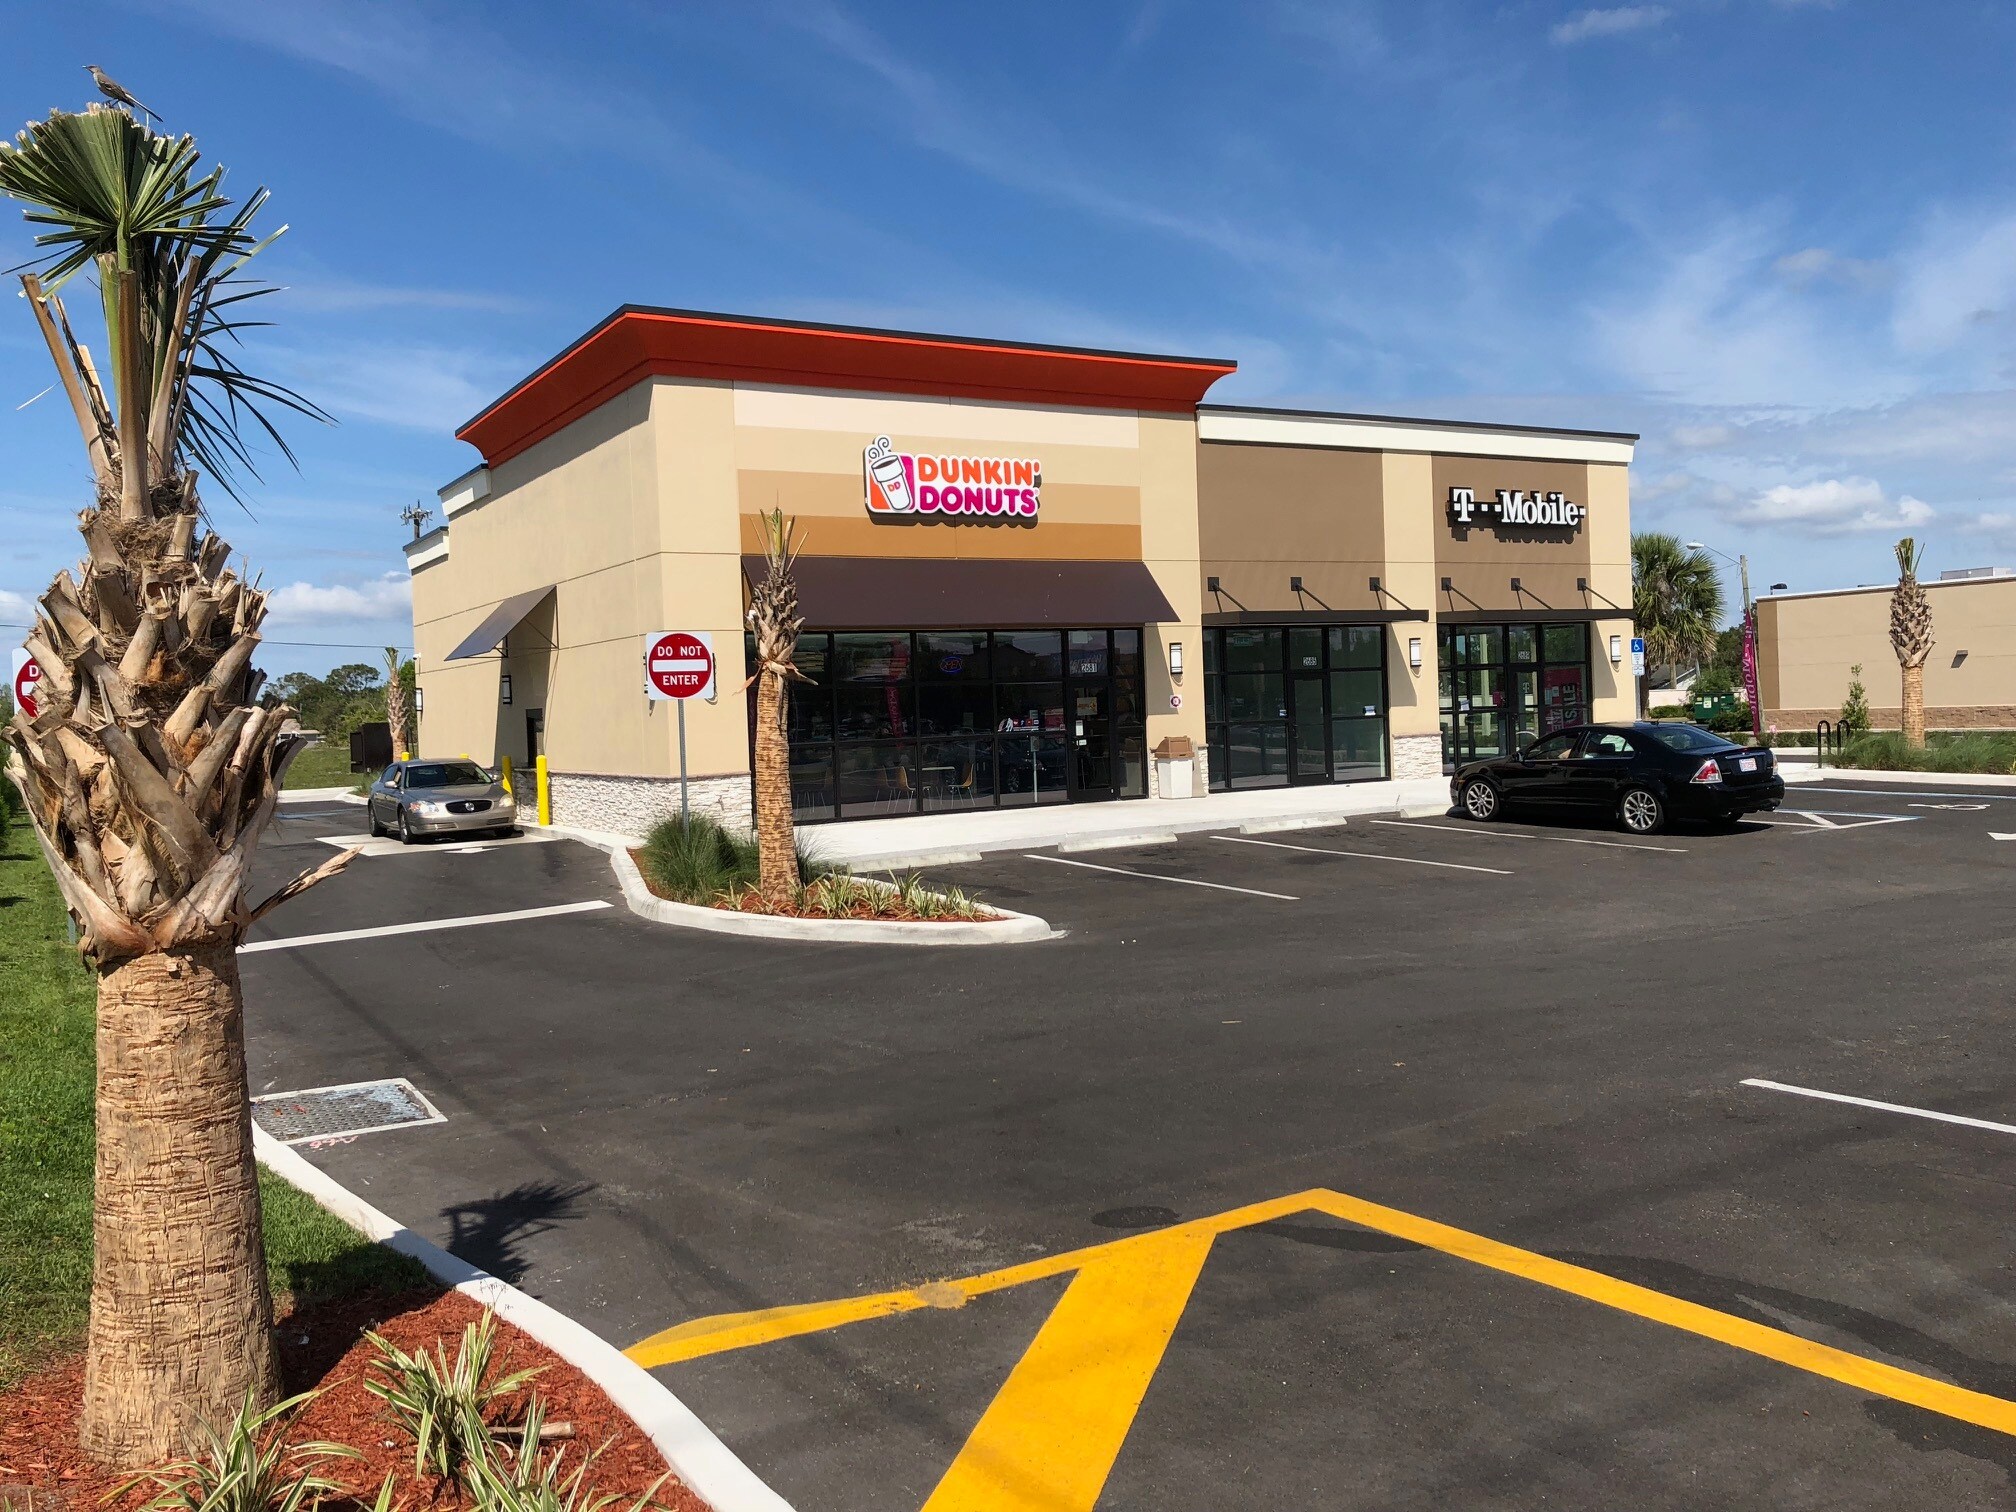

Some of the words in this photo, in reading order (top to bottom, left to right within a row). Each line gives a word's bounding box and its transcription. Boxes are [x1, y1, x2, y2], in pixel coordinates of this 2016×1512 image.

[918, 457, 1039, 486] DUNKIN'
[887, 481, 901, 492] DD
[919, 485, 1036, 515] DONUTS
[657, 646, 673, 657] DO
[680, 645, 702, 657] NOT
[28, 665, 39, 678] D
[662, 674, 699, 686] ENTER
